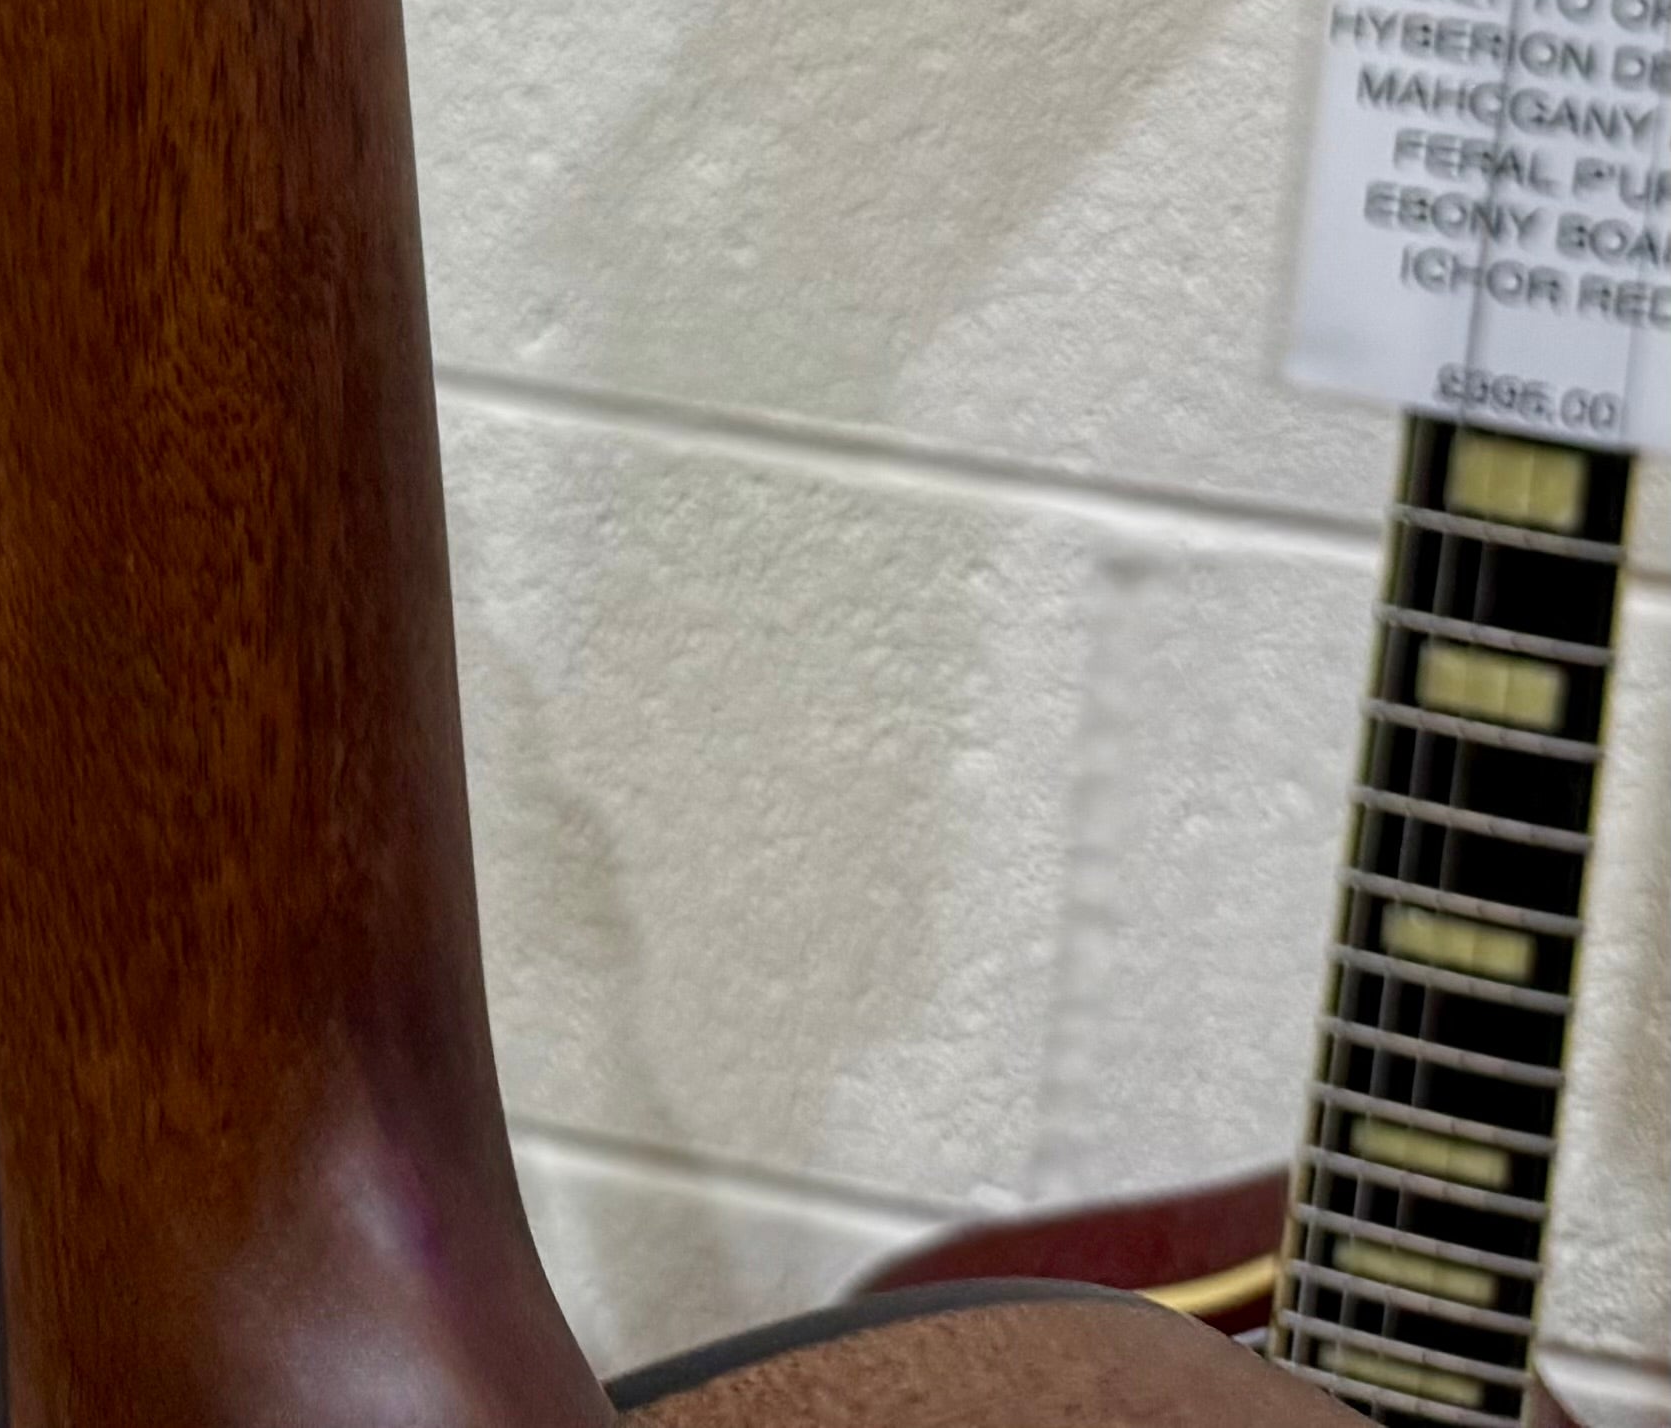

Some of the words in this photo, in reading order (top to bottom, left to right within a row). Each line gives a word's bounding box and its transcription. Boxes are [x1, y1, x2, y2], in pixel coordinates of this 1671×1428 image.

[1356, 63, 1656, 148] MAHOGANY
[1392, 127, 1558, 196] FERAL
[1363, 179, 1548, 248] EBONY
[1399, 243, 1570, 314] ICHOR
